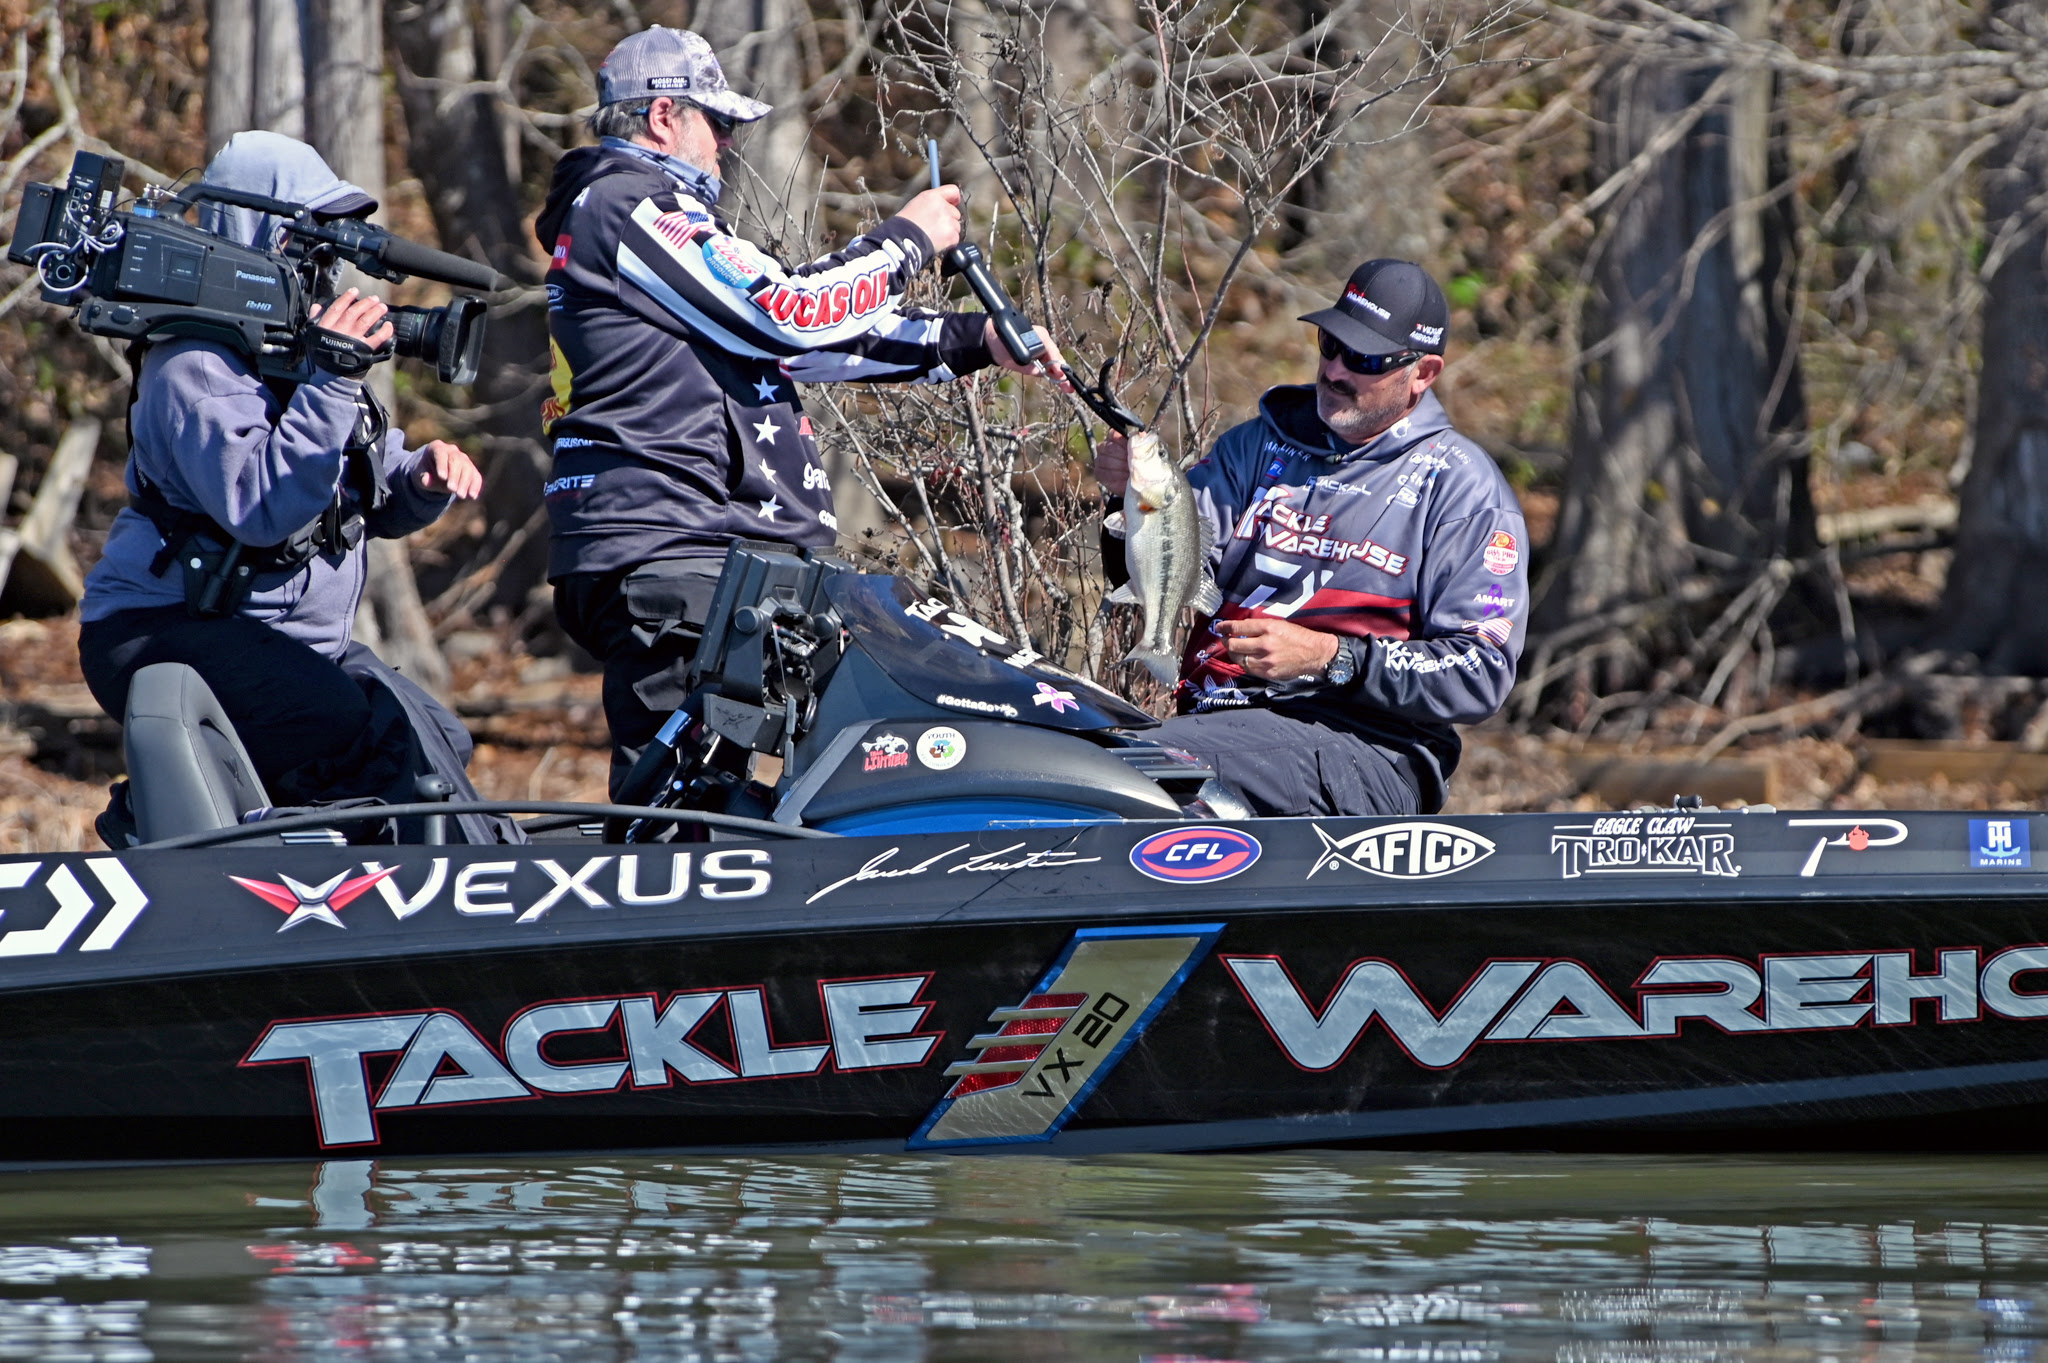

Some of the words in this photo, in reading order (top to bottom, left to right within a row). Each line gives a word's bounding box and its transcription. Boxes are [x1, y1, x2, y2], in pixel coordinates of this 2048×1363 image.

[236, 270, 276, 284] Panasonic
[706, 256, 739, 286] PRODUCTS
[712, 253, 745, 281] MARINE
[750, 281, 851, 330] LUCAS
[852, 266, 890, 317] OIL
[320, 336, 355, 350] FUJINON
[1234, 486, 1331, 539] TACKLE
[1473, 593, 1515, 607] AMART
[1592, 817, 1644, 835] EAGLE
[1647, 816, 1696, 835] CLAW
[1165, 843, 1224, 862] CFL
[1351, 828, 1477, 875] AFTCO
[1980, 858, 2022, 866] MARINE
[361, 849, 772, 924] VEXUS
[1021, 1047, 1086, 1098] VX
[1072, 991, 1130, 1049] 20
[239, 972, 946, 1149] TACKLE
